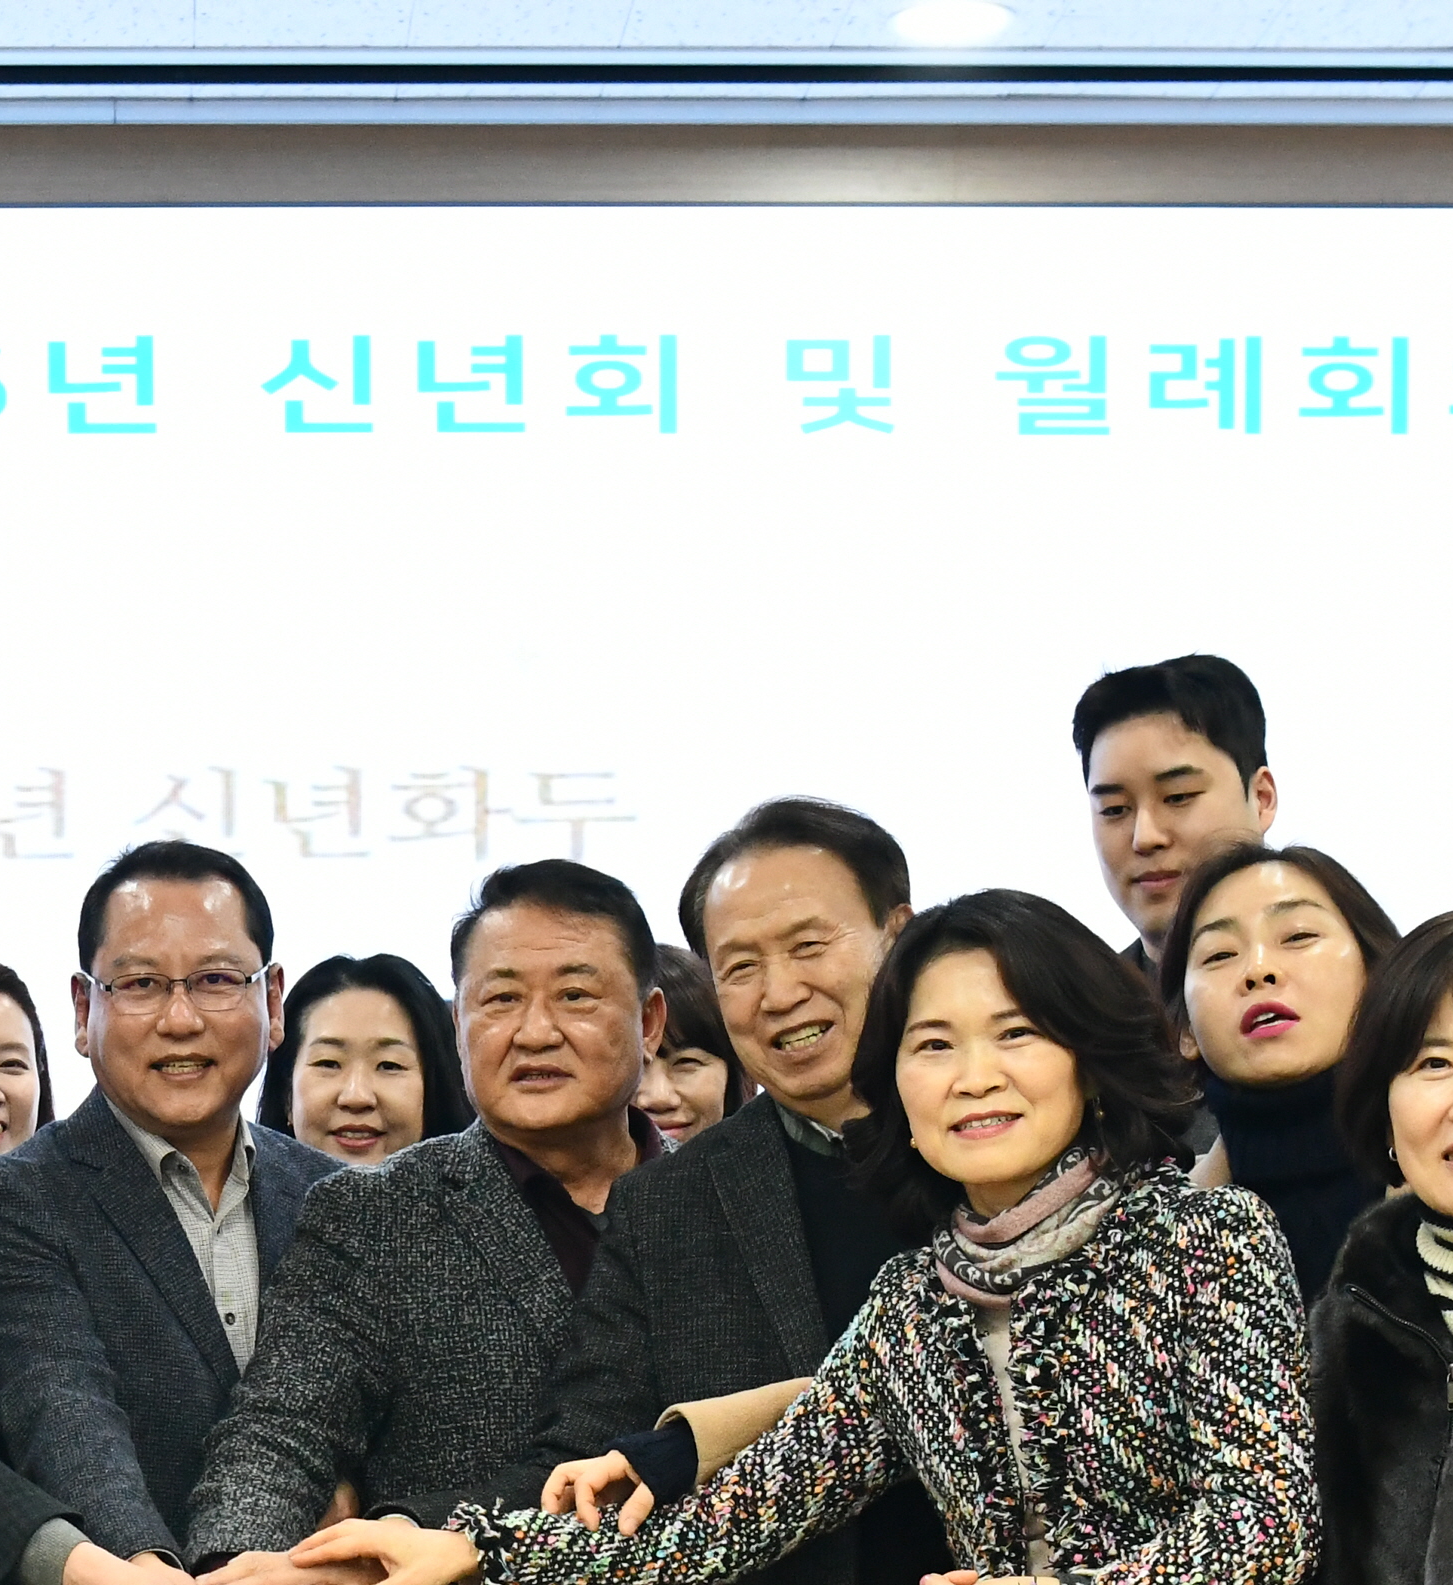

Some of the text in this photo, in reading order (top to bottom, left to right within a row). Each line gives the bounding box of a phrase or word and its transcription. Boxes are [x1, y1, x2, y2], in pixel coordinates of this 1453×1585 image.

[261, 334, 677, 435] 신년회
[785, 334, 895, 435] 및
[132, 764, 638, 864] 신년화두
